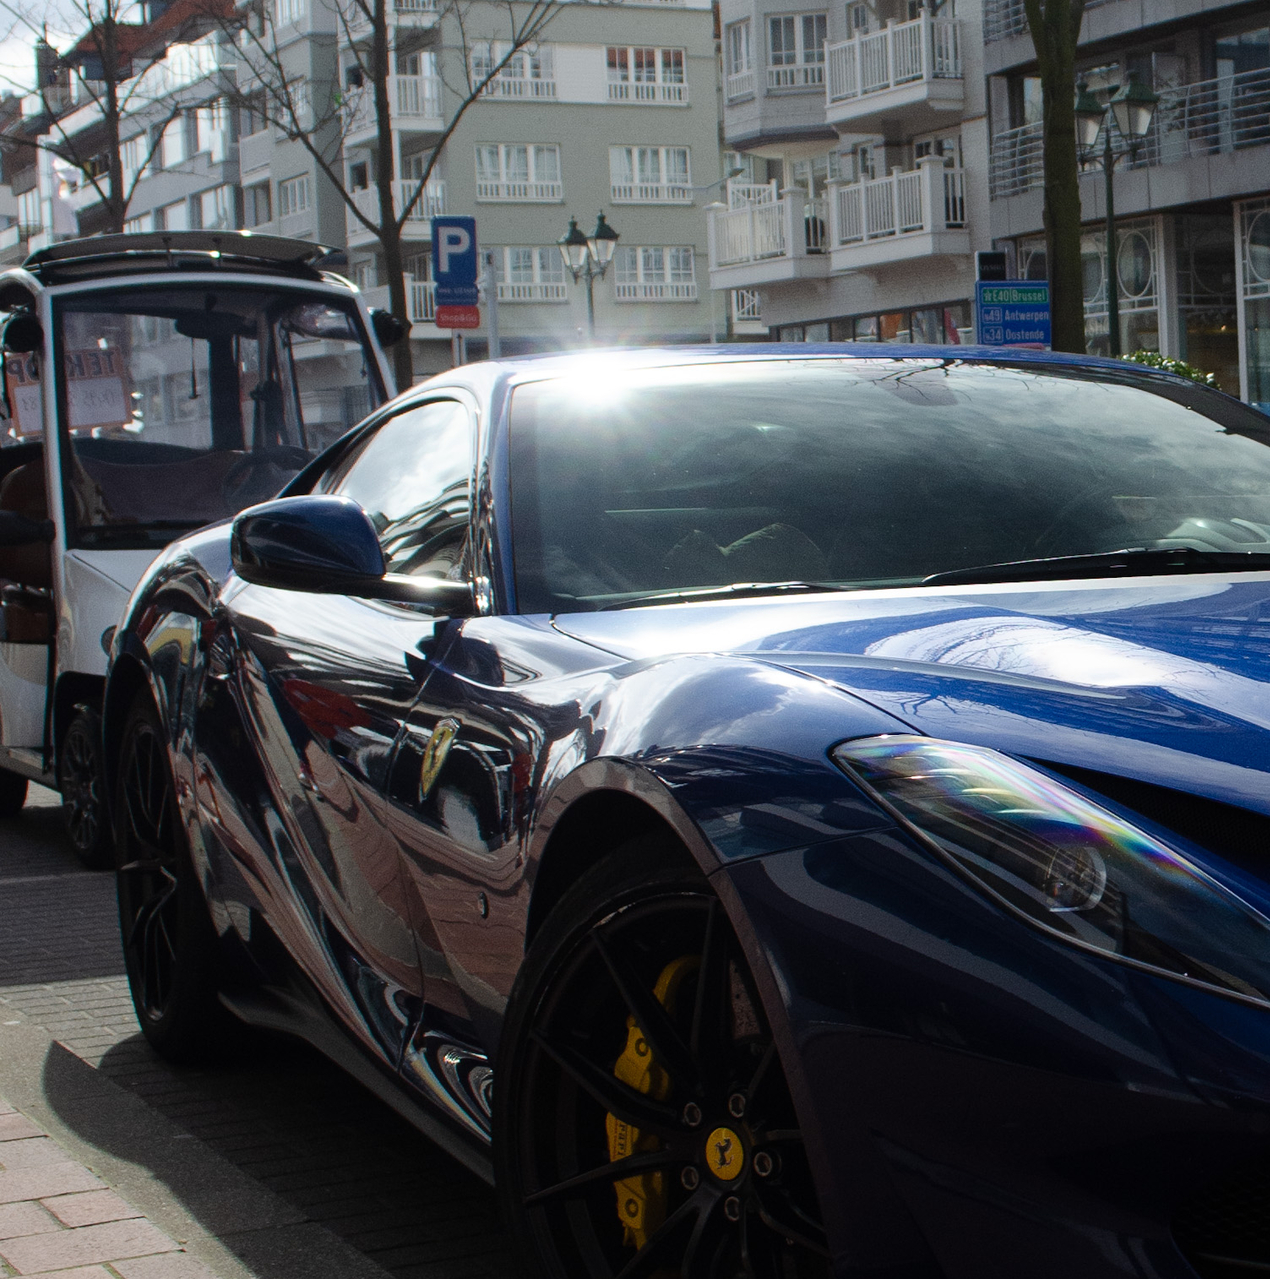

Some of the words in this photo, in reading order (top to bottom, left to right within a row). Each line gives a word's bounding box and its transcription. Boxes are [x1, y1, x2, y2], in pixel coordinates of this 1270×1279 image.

[438, 226, 470, 273] P
[993, 288, 1010, 303] E40
[1011, 288, 1046, 303] Brussel
[1004, 309, 1049, 323] Antwerpen
[1005, 327, 1045, 340] Oostende
